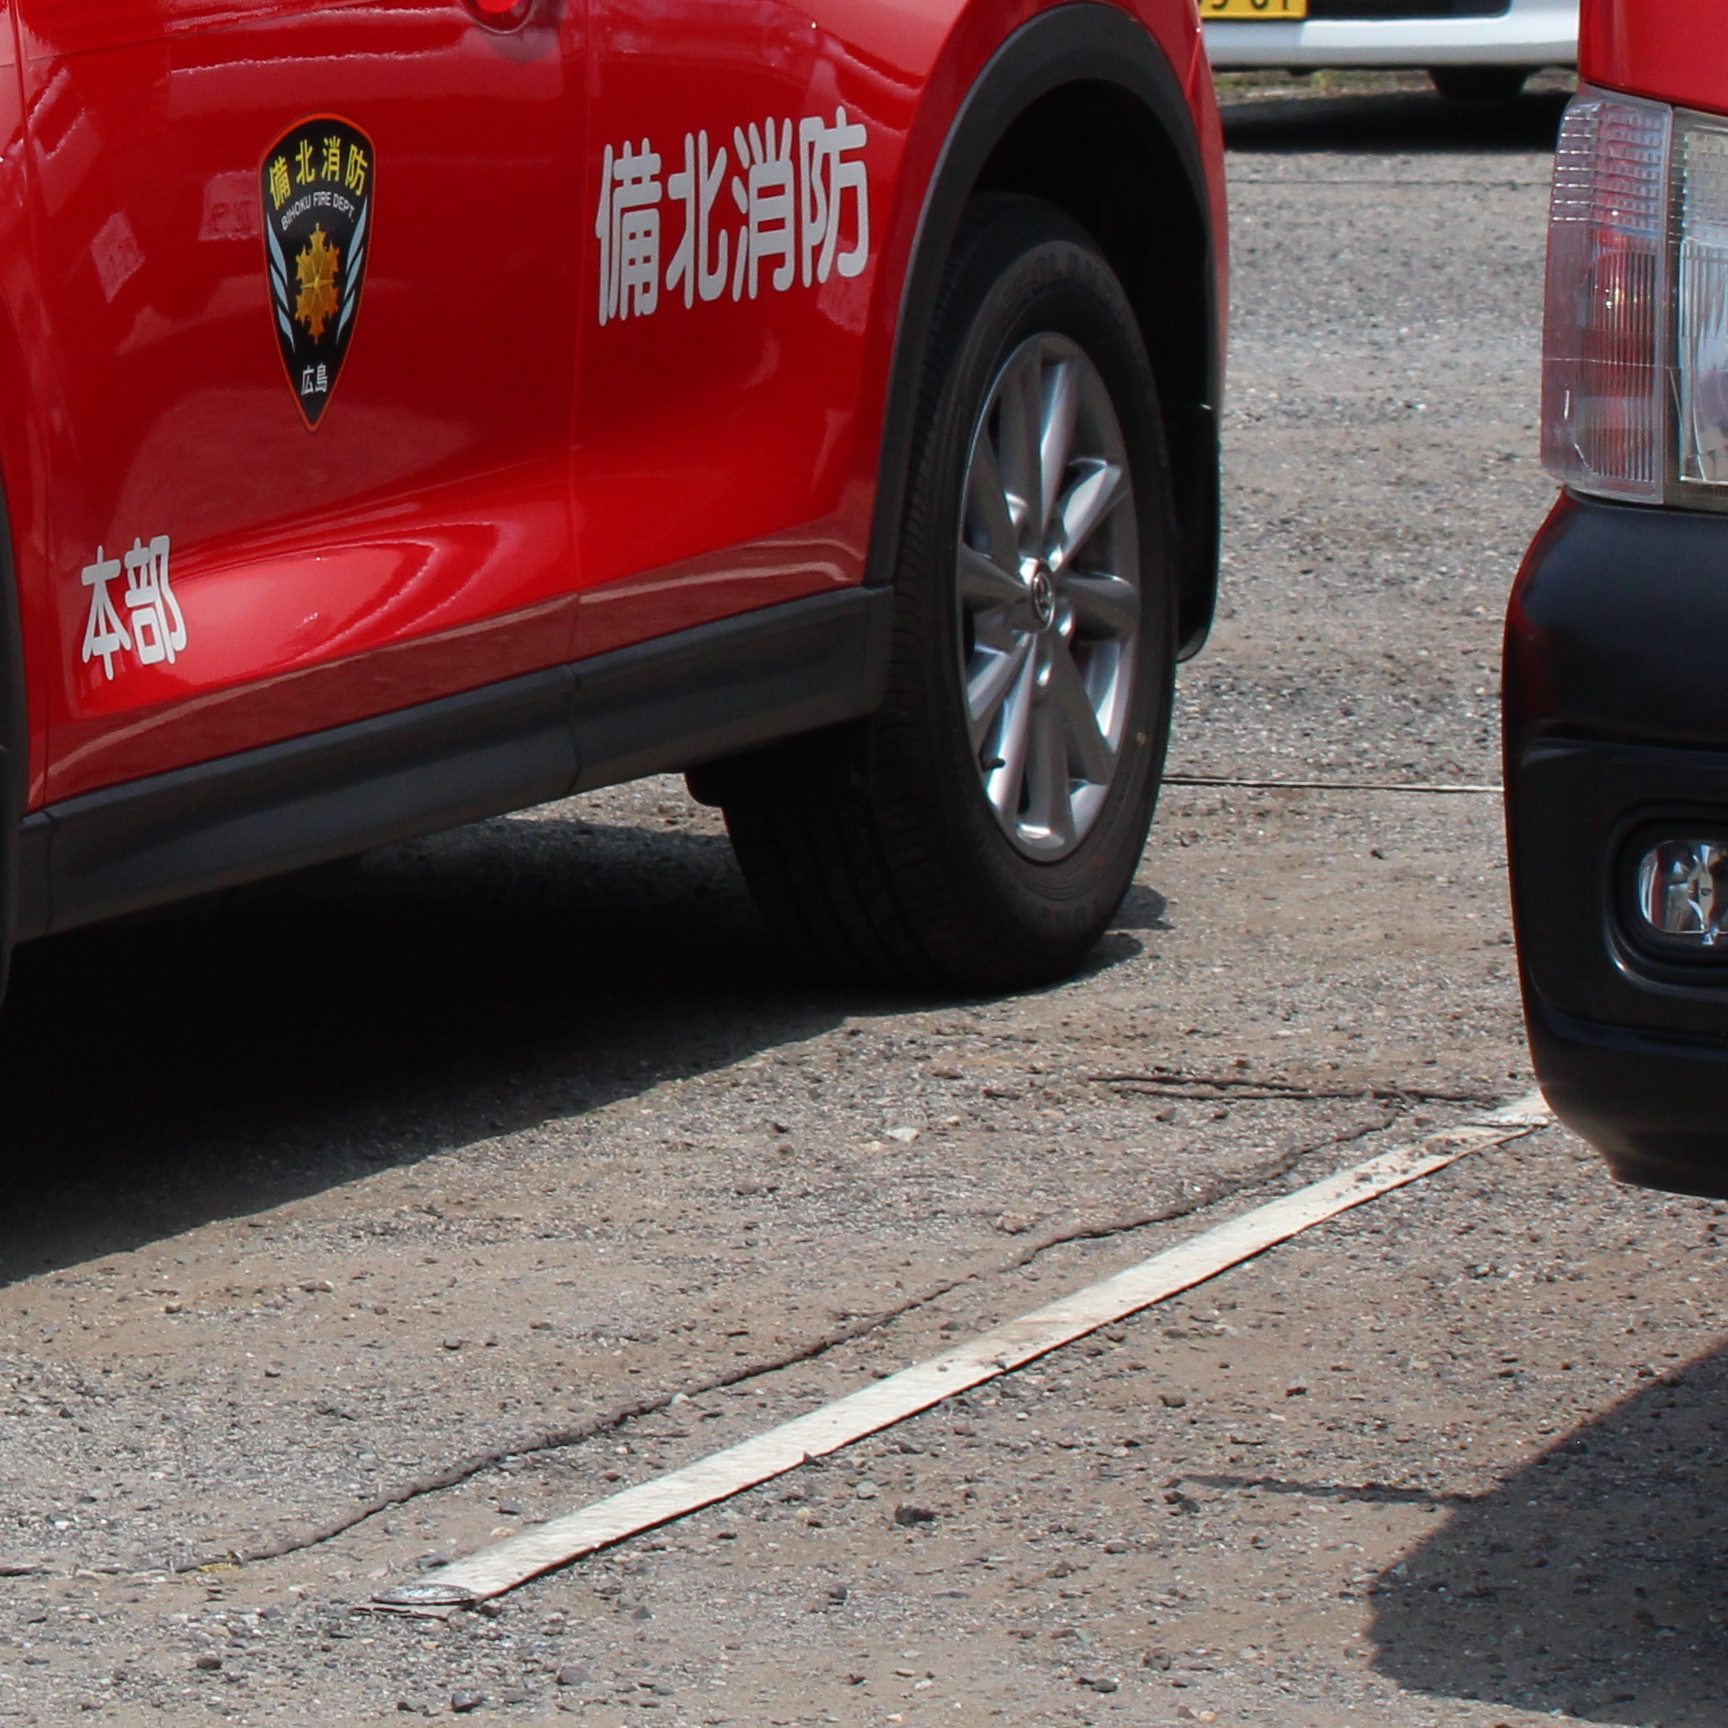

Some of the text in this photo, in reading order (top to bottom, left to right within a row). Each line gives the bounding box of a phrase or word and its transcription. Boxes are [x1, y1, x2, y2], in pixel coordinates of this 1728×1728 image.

[268, 135, 368, 211] 備北消防
[280, 194, 313, 232] BIHOKU
[313, 190, 332, 207] FIRE
[595, 105, 869, 327] 備北消防
[301, 362, 328, 396] 広島
[81, 535, 188, 681] 本部
